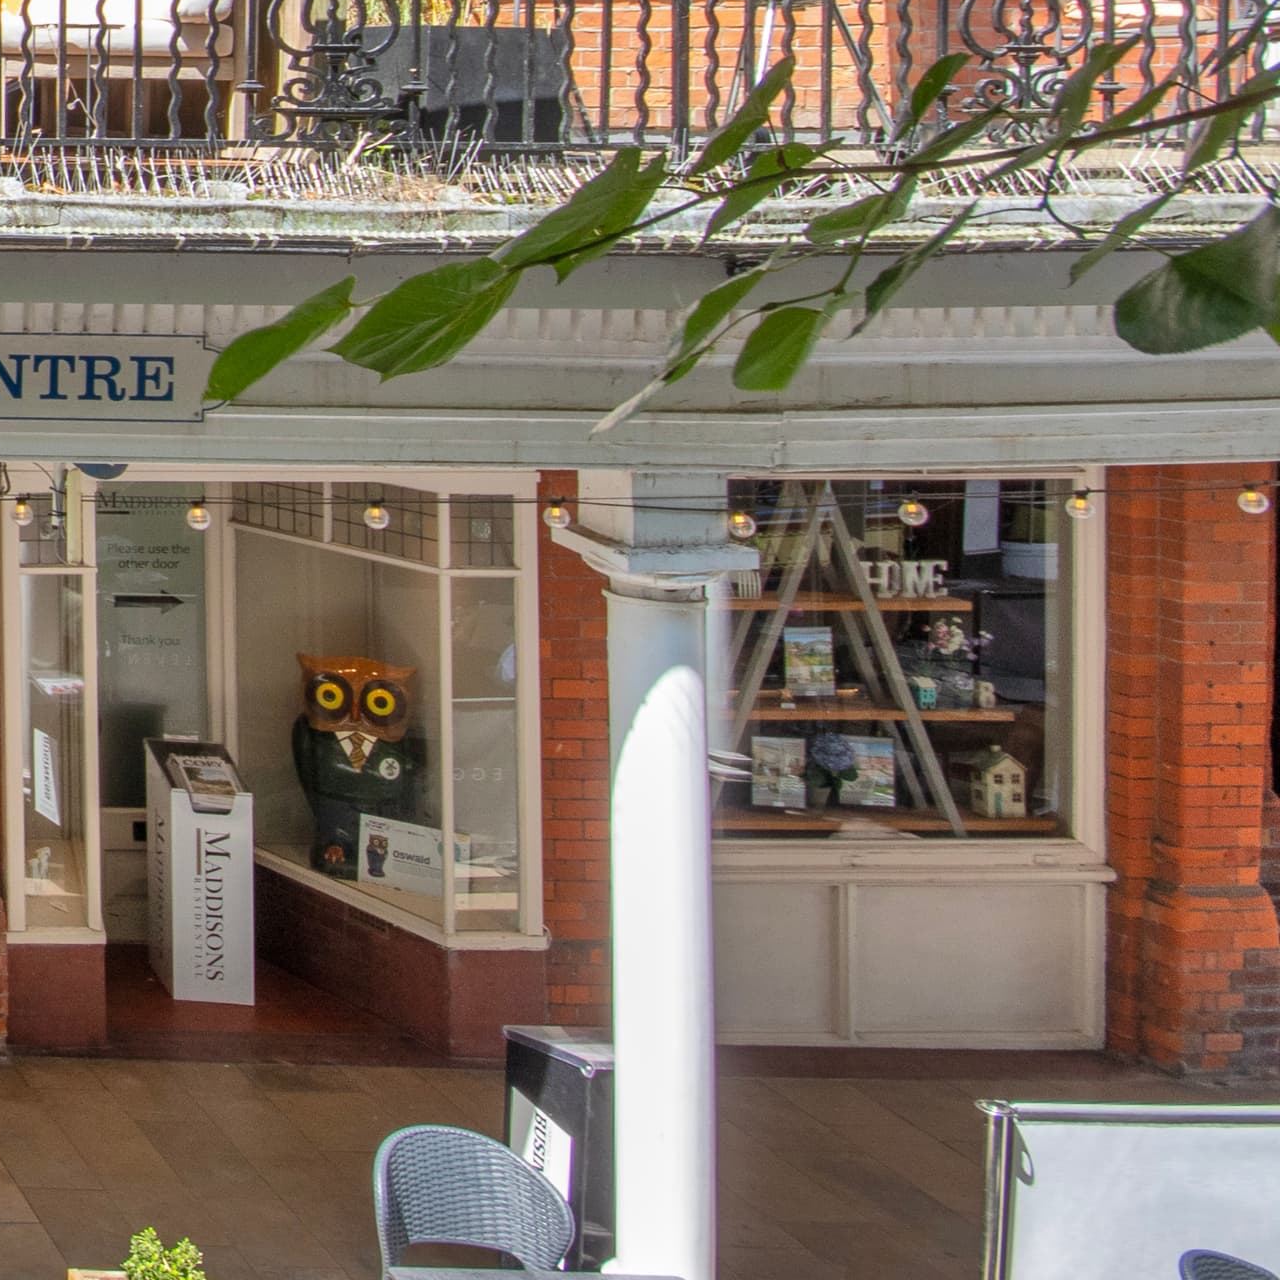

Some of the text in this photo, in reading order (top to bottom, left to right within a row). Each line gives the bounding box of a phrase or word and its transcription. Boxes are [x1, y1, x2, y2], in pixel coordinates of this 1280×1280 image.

[108, 544, 190, 554] Please use the
[118, 559, 180, 569] other door
[120, 635, 180, 648] Thank you
[392, 850, 431, 865] Oswald
[204, 830, 231, 981] MADDISONS
[194, 877, 203, 977] RESIDENTIAL
